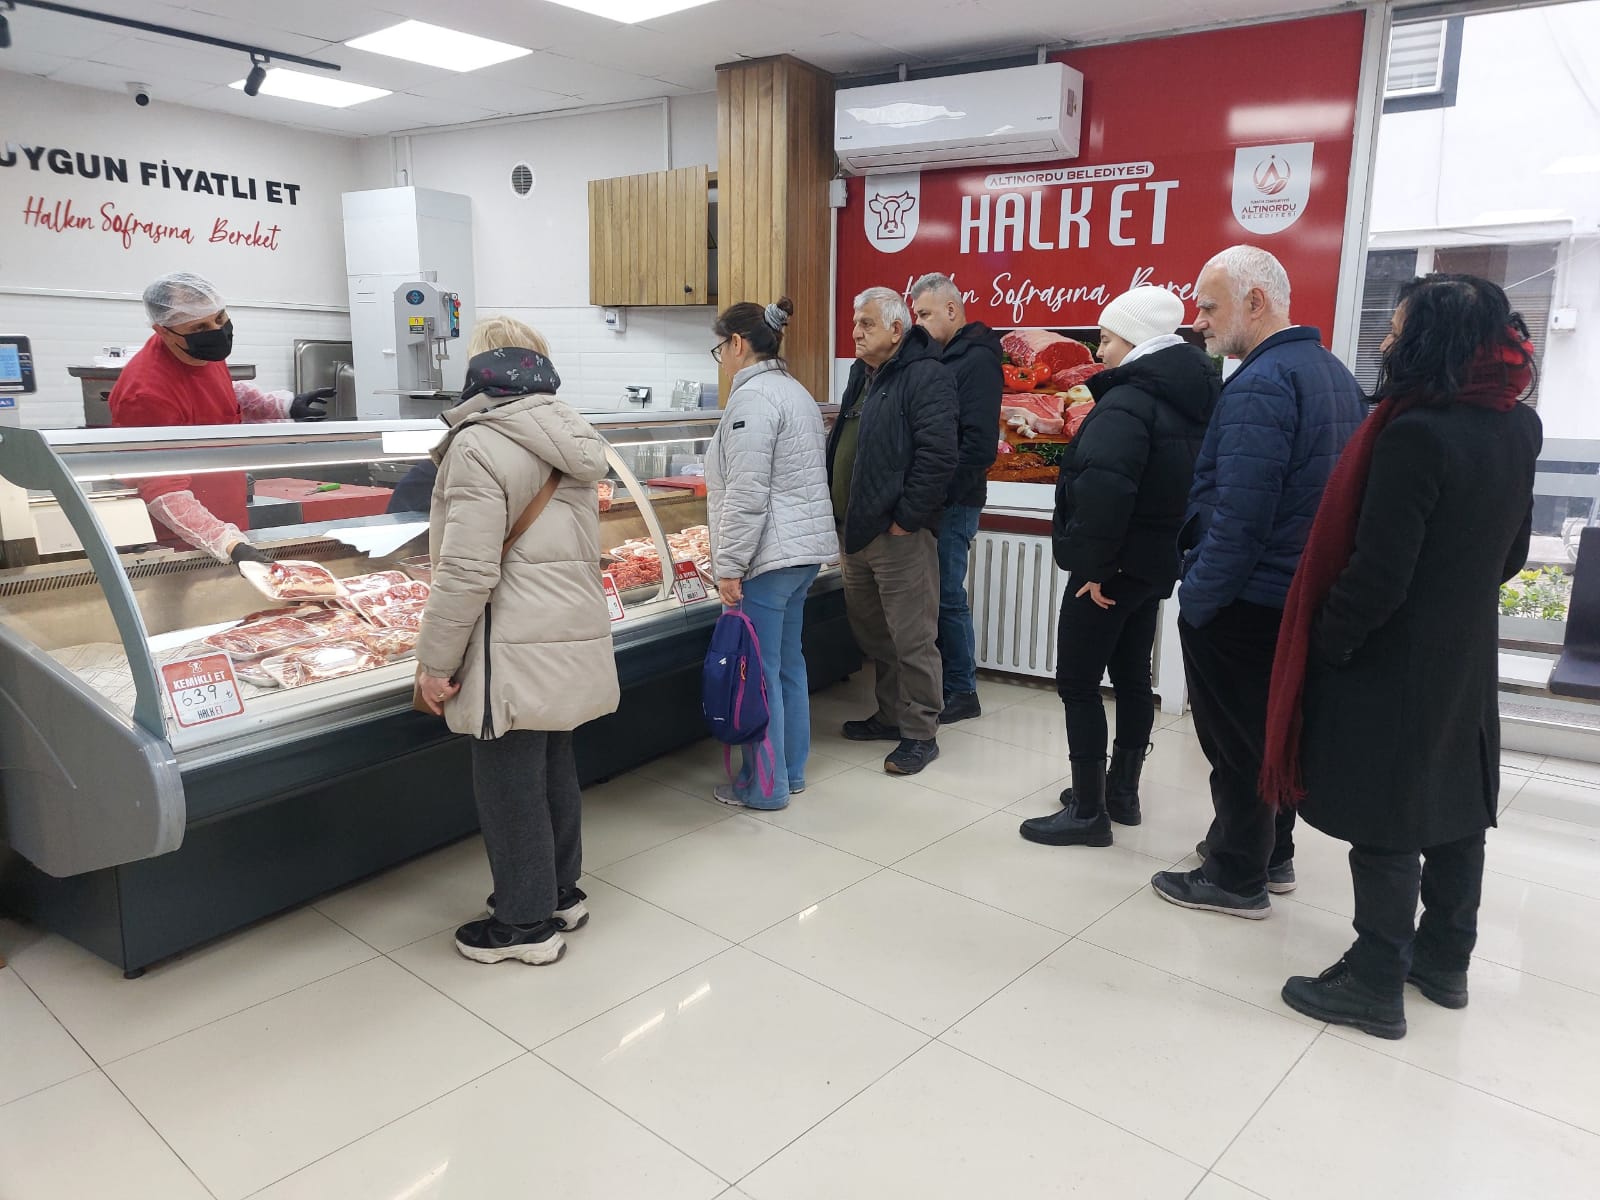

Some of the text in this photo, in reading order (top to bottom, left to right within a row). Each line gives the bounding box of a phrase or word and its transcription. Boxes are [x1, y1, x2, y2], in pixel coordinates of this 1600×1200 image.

[139, 160, 257, 200] FİYATLI
[265, 181, 300, 205] ET
[990, 165, 1149, 187] ALTINORDU BELEDİYESİ
[23, 196, 95, 233] Halkın
[208, 217, 282, 251] Bereket
[960, 180, 1180, 254] HALK ET
[1242, 204, 1296, 213] ALTINORDU
[990, 272, 1111, 324] Sofrasına
[173, 671, 225, 690] KEMİKLİ ET
[182, 685, 217, 706] 639
